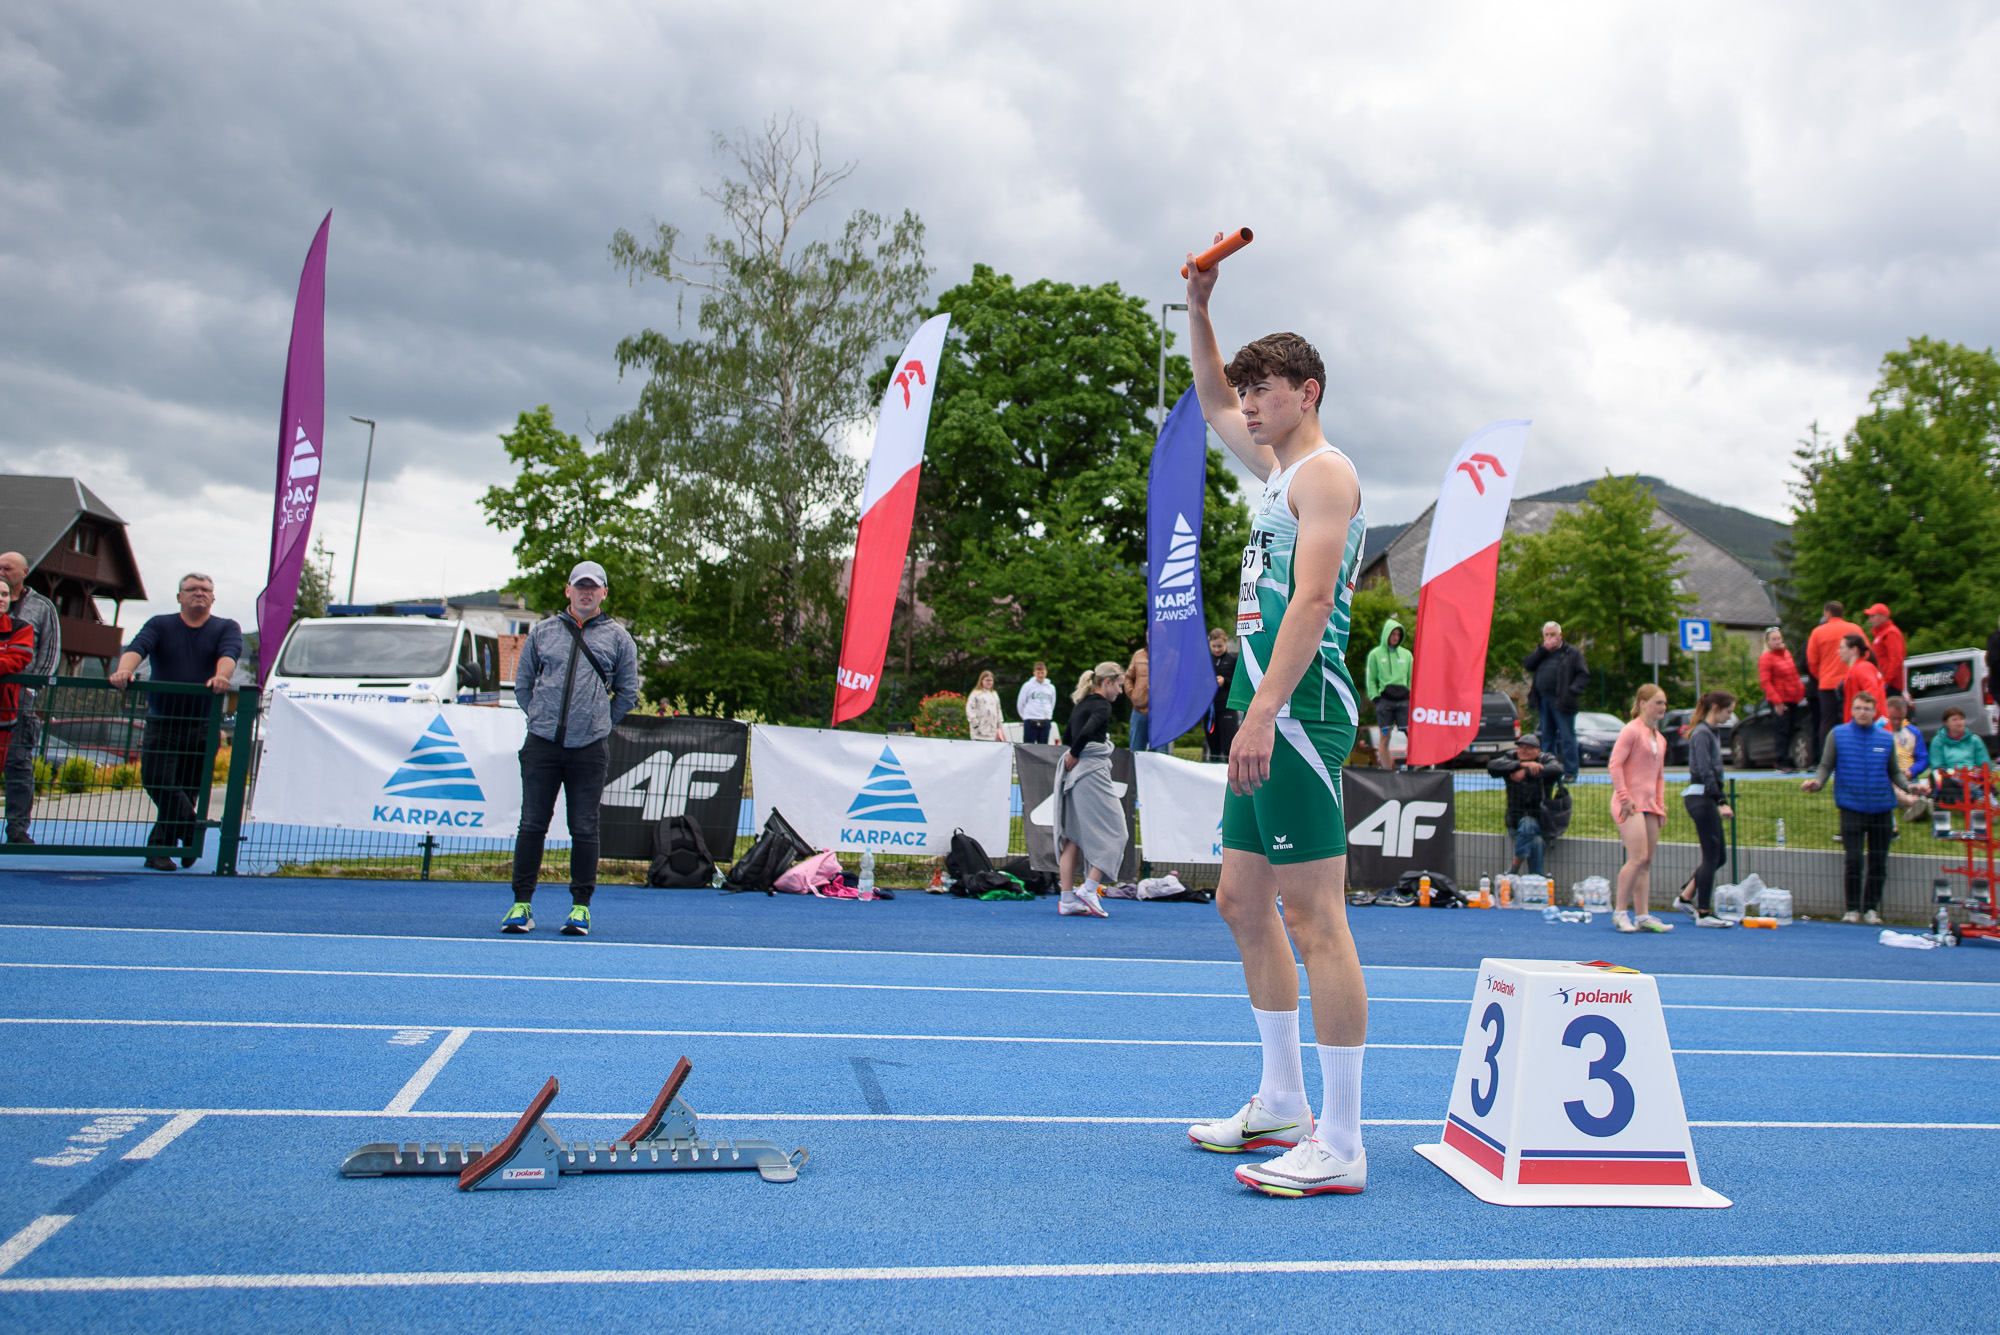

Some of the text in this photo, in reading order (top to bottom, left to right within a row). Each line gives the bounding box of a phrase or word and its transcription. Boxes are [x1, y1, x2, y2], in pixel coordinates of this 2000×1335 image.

[1686, 622, 1705, 648] P
[1911, 670, 1954, 691] sigmatec
[1412, 707, 1471, 727] ORLEN
[600, 750, 738, 820] 4F
[372, 805, 485, 828] KARPACZ
[840, 828, 927, 846] KARPACZ
[1348, 799, 1448, 858] 4F
[1491, 979, 1516, 998] polanik
[1574, 988, 1633, 1007] polanik
[1471, 1002, 1505, 1118] 3
[1561, 1014, 1635, 1138] 3
[515, 1169, 543, 1178] polanik
